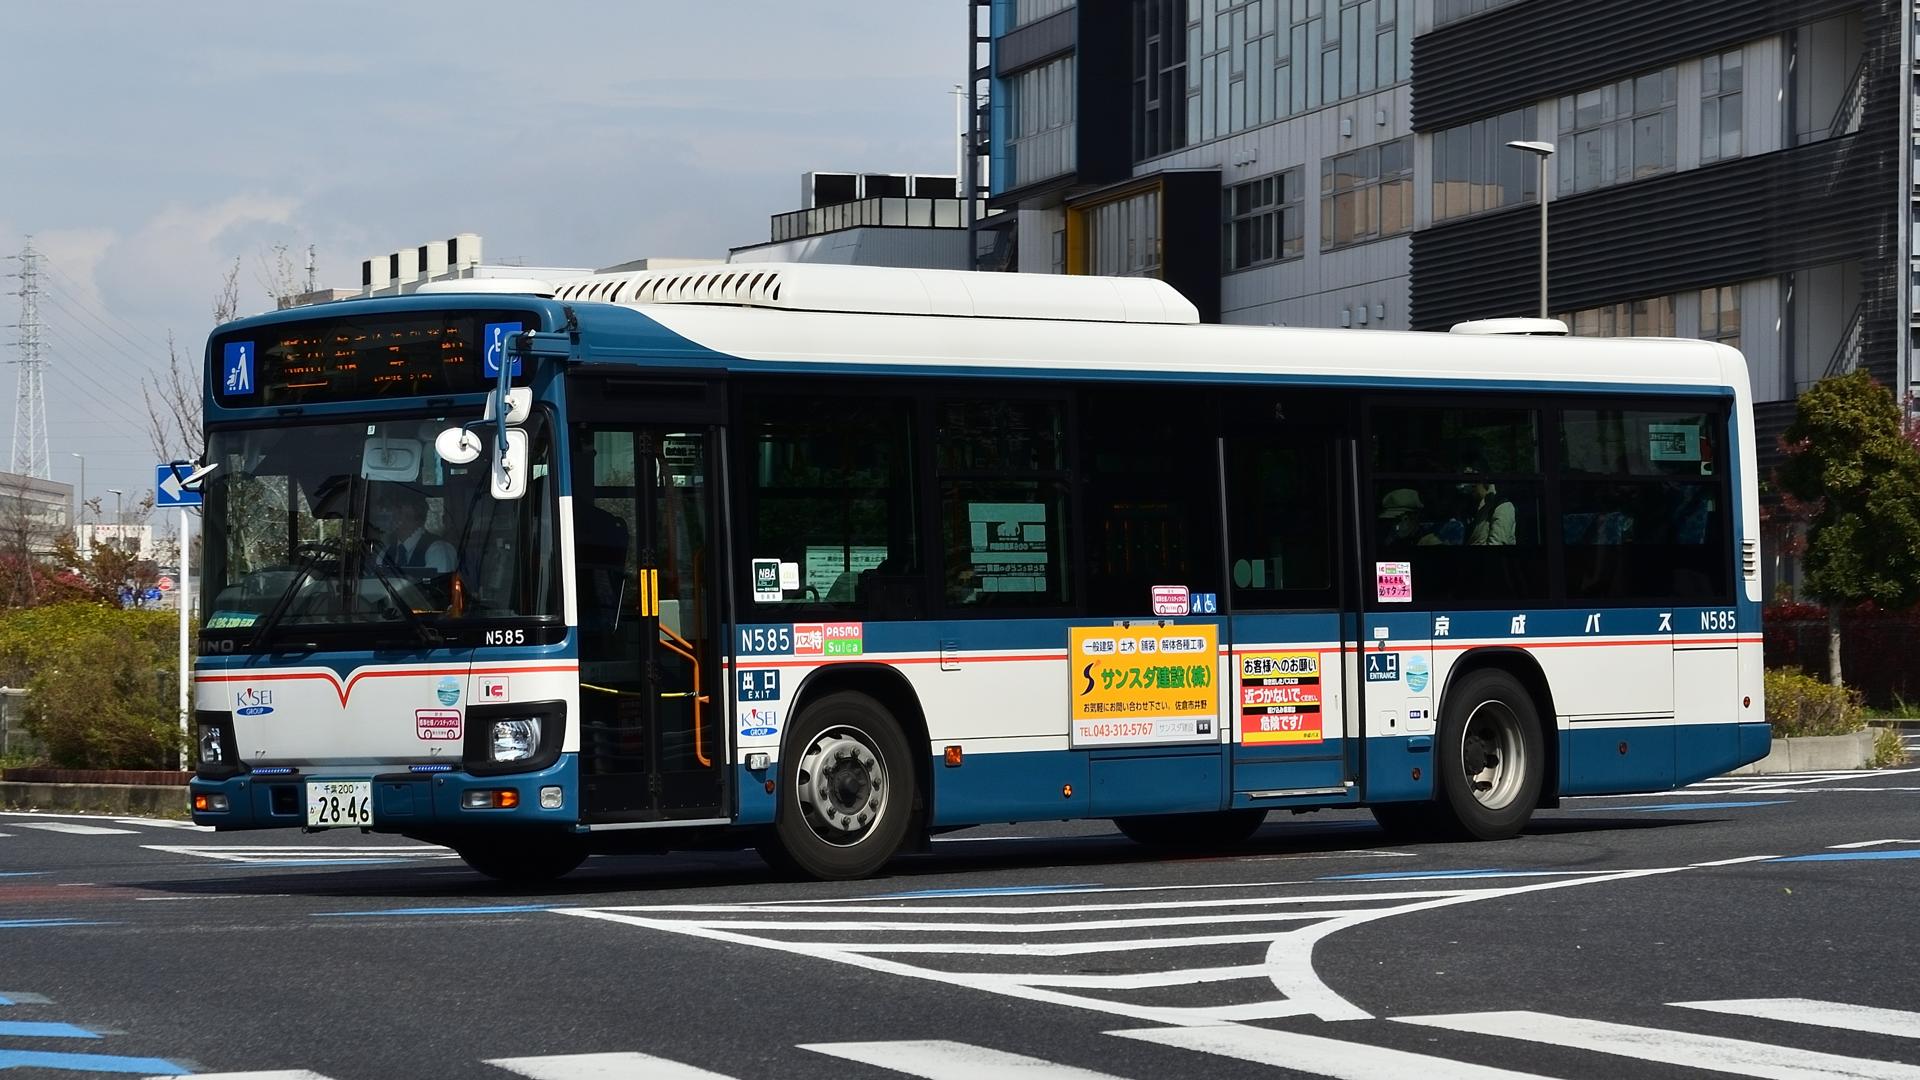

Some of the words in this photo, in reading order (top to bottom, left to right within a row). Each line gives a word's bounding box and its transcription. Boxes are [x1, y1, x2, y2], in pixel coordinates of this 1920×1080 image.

[758, 568, 776, 580] NBA
[1700, 611, 1737, 630] N585
[485, 629, 525, 645] N585
[826, 626, 860, 637] PASMO
[198, 640, 234, 653] INO
[742, 629, 790, 652] N585
[828, 642, 859, 653] Suica
[1085, 641, 1114, 652] 一般建築
[1120, 640, 1135, 651] 土木
[1161, 638, 1205, 650] 解体各種工事
[1244, 658, 1317, 674] お客様へのお願い
[1369, 655, 1397, 672] 入口
[743, 672, 775, 690] 出口
[748, 690, 770, 699] EXIT
[246, 707, 264, 715] GROUP
[1175, 700, 1208, 711] 佐倉市井野
[750, 728, 768, 736] GROUP
[1079, 722, 1153, 737] TEL.043-312-5767
[318, 796, 370, 823] 28-46
